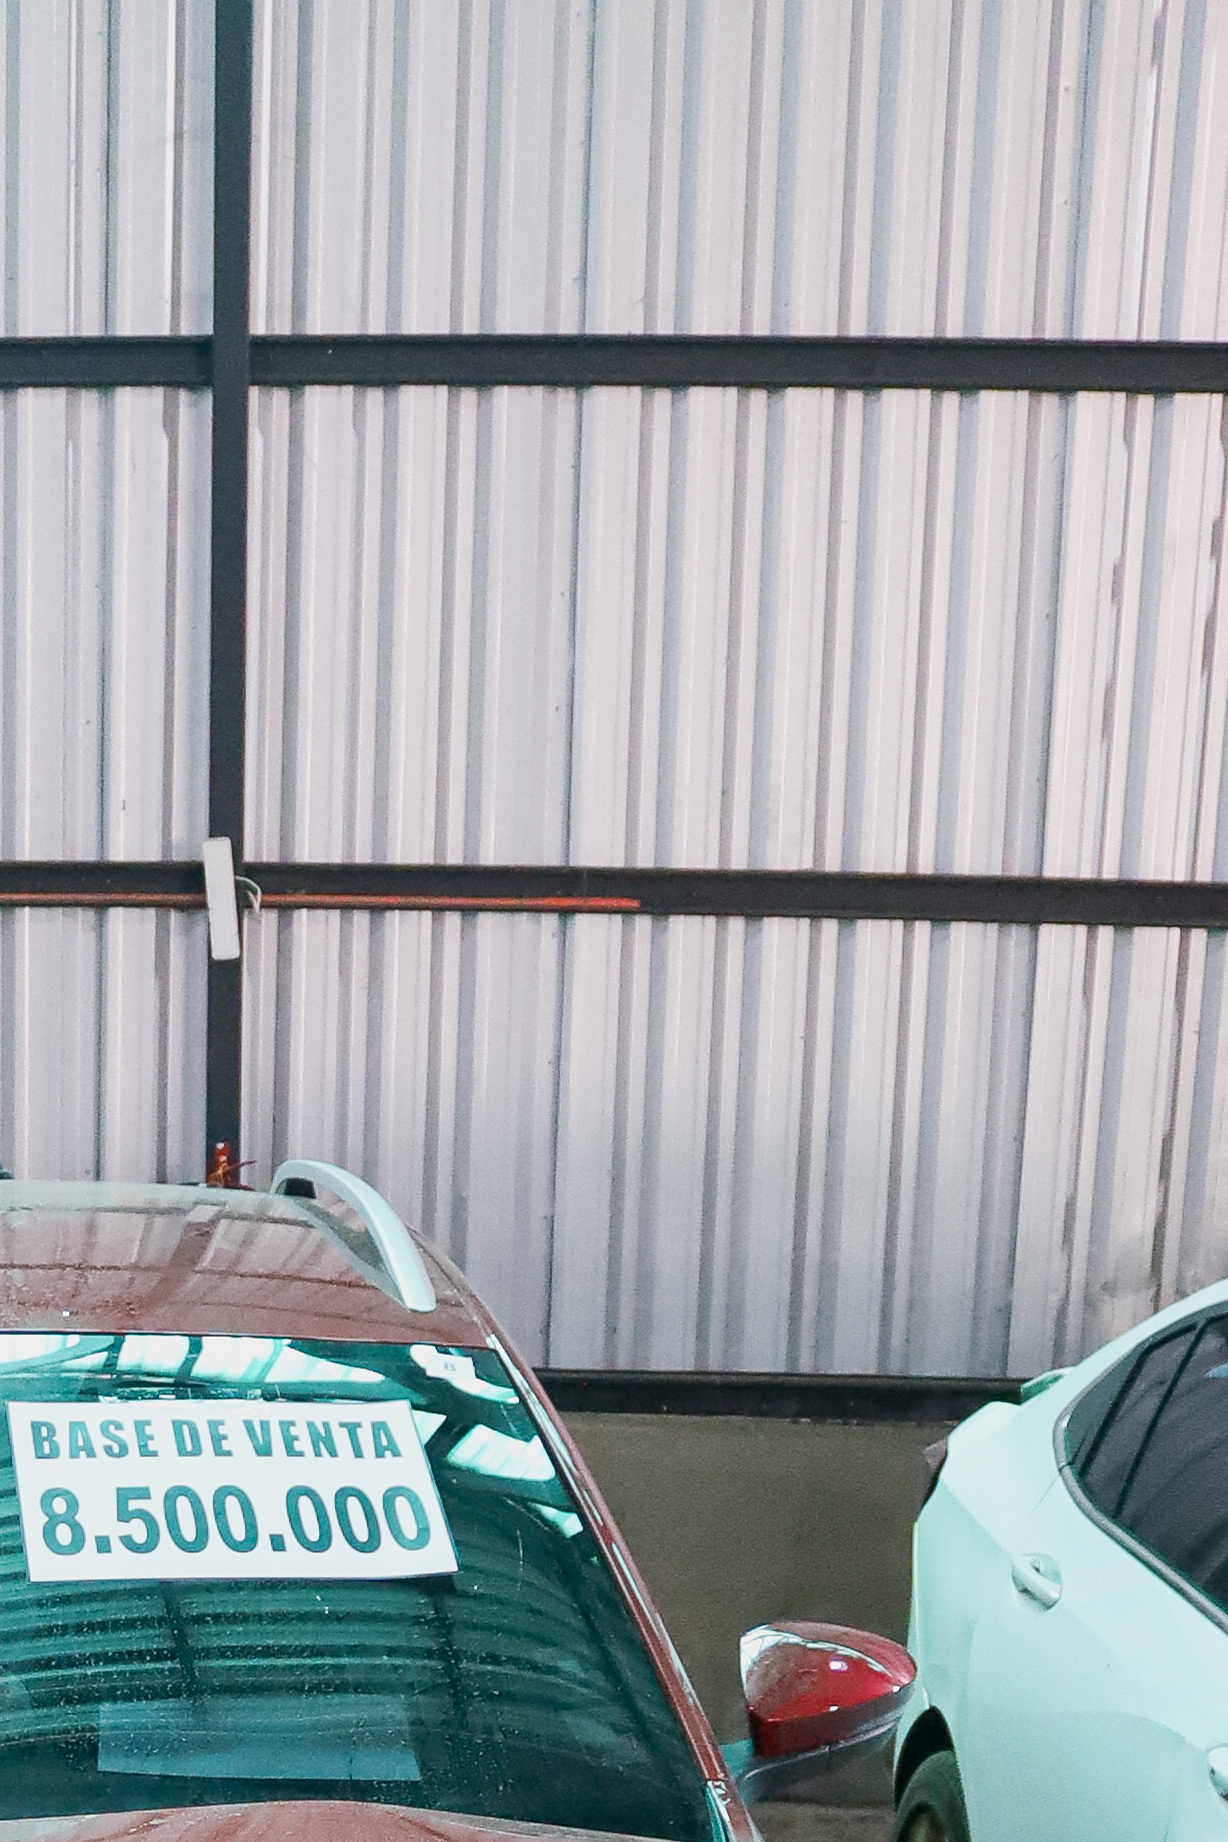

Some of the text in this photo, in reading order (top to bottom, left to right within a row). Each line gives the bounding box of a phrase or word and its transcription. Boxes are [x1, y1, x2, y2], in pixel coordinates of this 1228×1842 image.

[30, 1419, 403, 1459] BASE DE VENTA
[40, 1484, 431, 1556] 8.500.000
